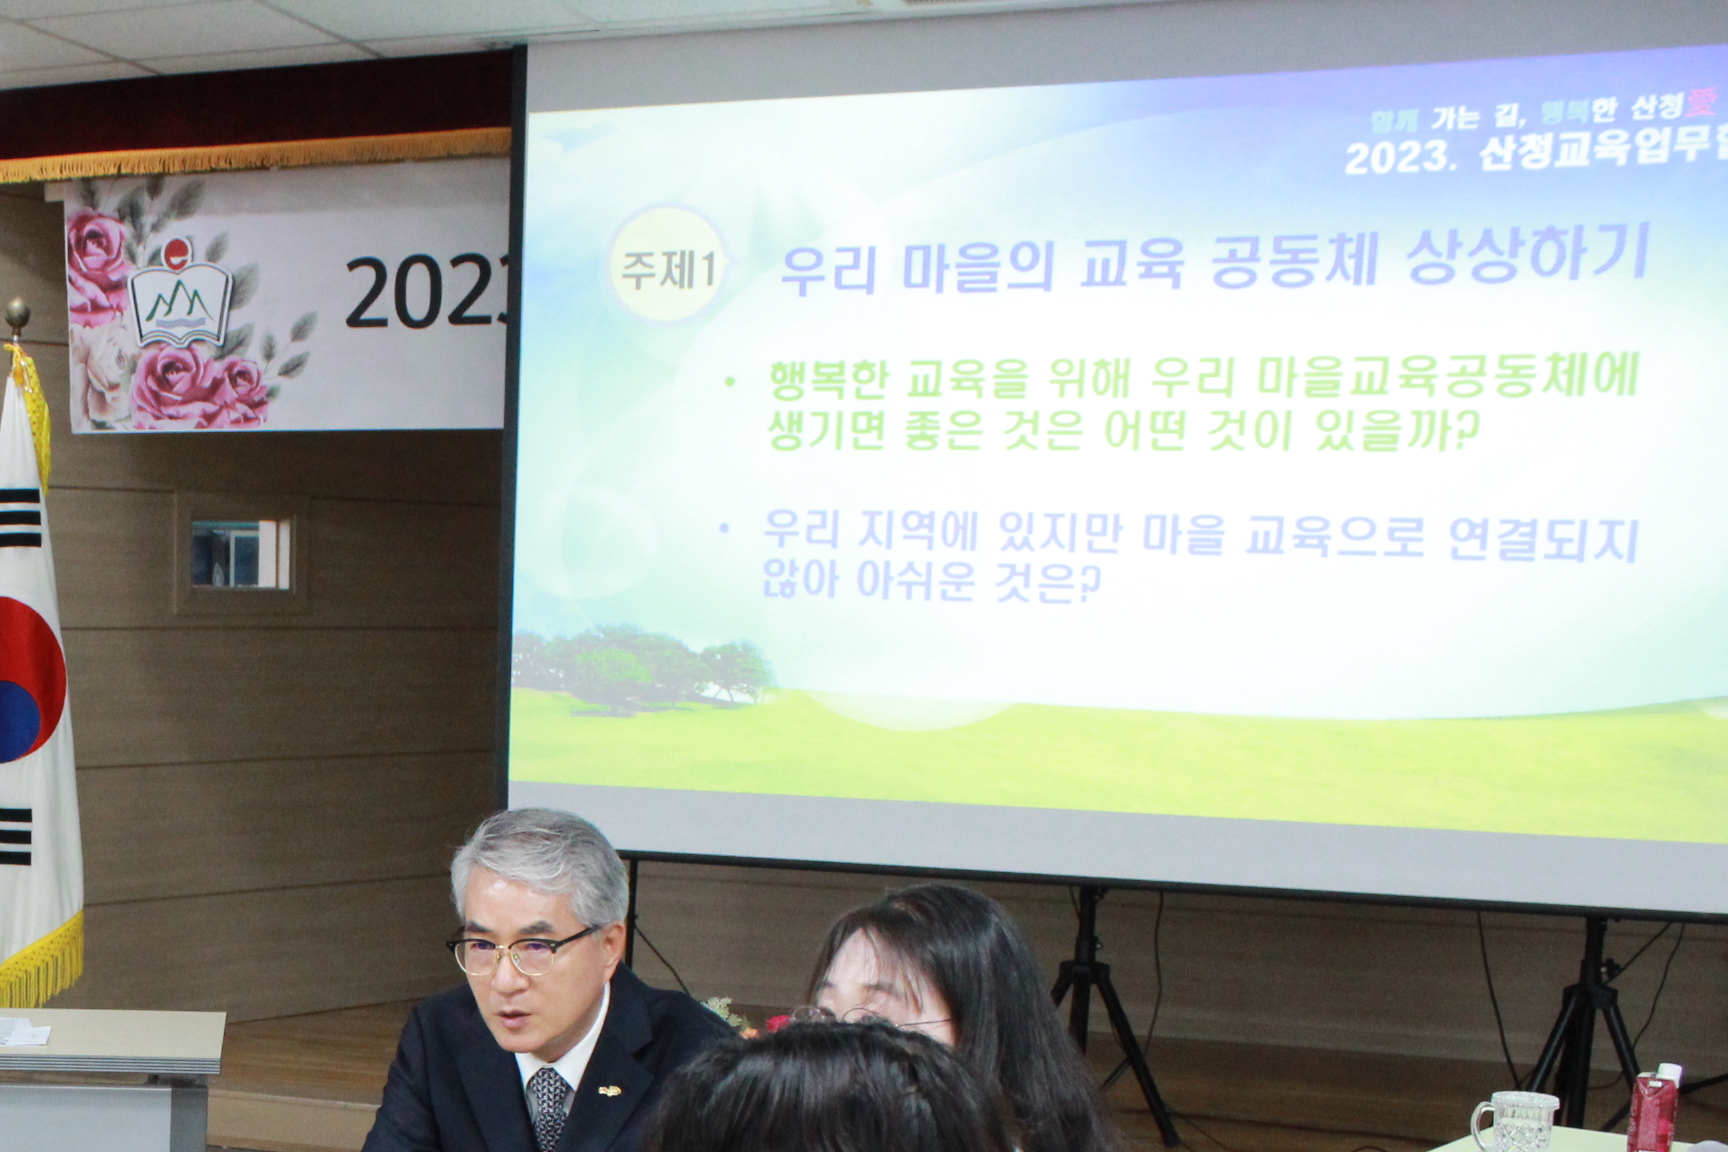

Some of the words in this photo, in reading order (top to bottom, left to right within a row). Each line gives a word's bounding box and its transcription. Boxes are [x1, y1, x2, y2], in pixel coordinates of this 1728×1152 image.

[1430, 105, 1481, 131] 가는
[1494, 102, 1526, 129] 길,
[1541, 97, 1618, 126] 행복한
[1345, 139, 1458, 175] 2023.
[622, 250, 717, 290] 주제1
[781, 245, 877, 297] 우리
[903, 240, 1055, 294] 마을의
[1080, 238, 1185, 290] 교육
[1211, 231, 1379, 289] 공동체
[1406, 221, 1651, 286] 상상하기
[770, 359, 890, 402] 행복한
[907, 358, 1029, 400] 교육을
[1048, 356, 1131, 400] 위해
[1151, 355, 1236, 399] 우리
[1257, 350, 1641, 400] 마을교육공동체에
[768, 409, 886, 452] 생기면
[904, 410, 984, 451] 좋은
[1003, 410, 1084, 451] 것은
[1104, 409, 1187, 453] 어떤
[1208, 409, 1293, 453] 것이
[1315, 408, 1482, 453] 있을까?
[763, 508, 840, 550] 우리
[858, 508, 979, 552] 지역에
[998, 510, 1123, 555] 있지만
[1143, 513, 1226, 557] 마을
[1245, 514, 1427, 558] 교육으로
[1448, 516, 1641, 565] 연결되지
[762, 558, 841, 600] 않아
[856, 559, 976, 602] 아쉬운
[994, 562, 1102, 605] 것은?
